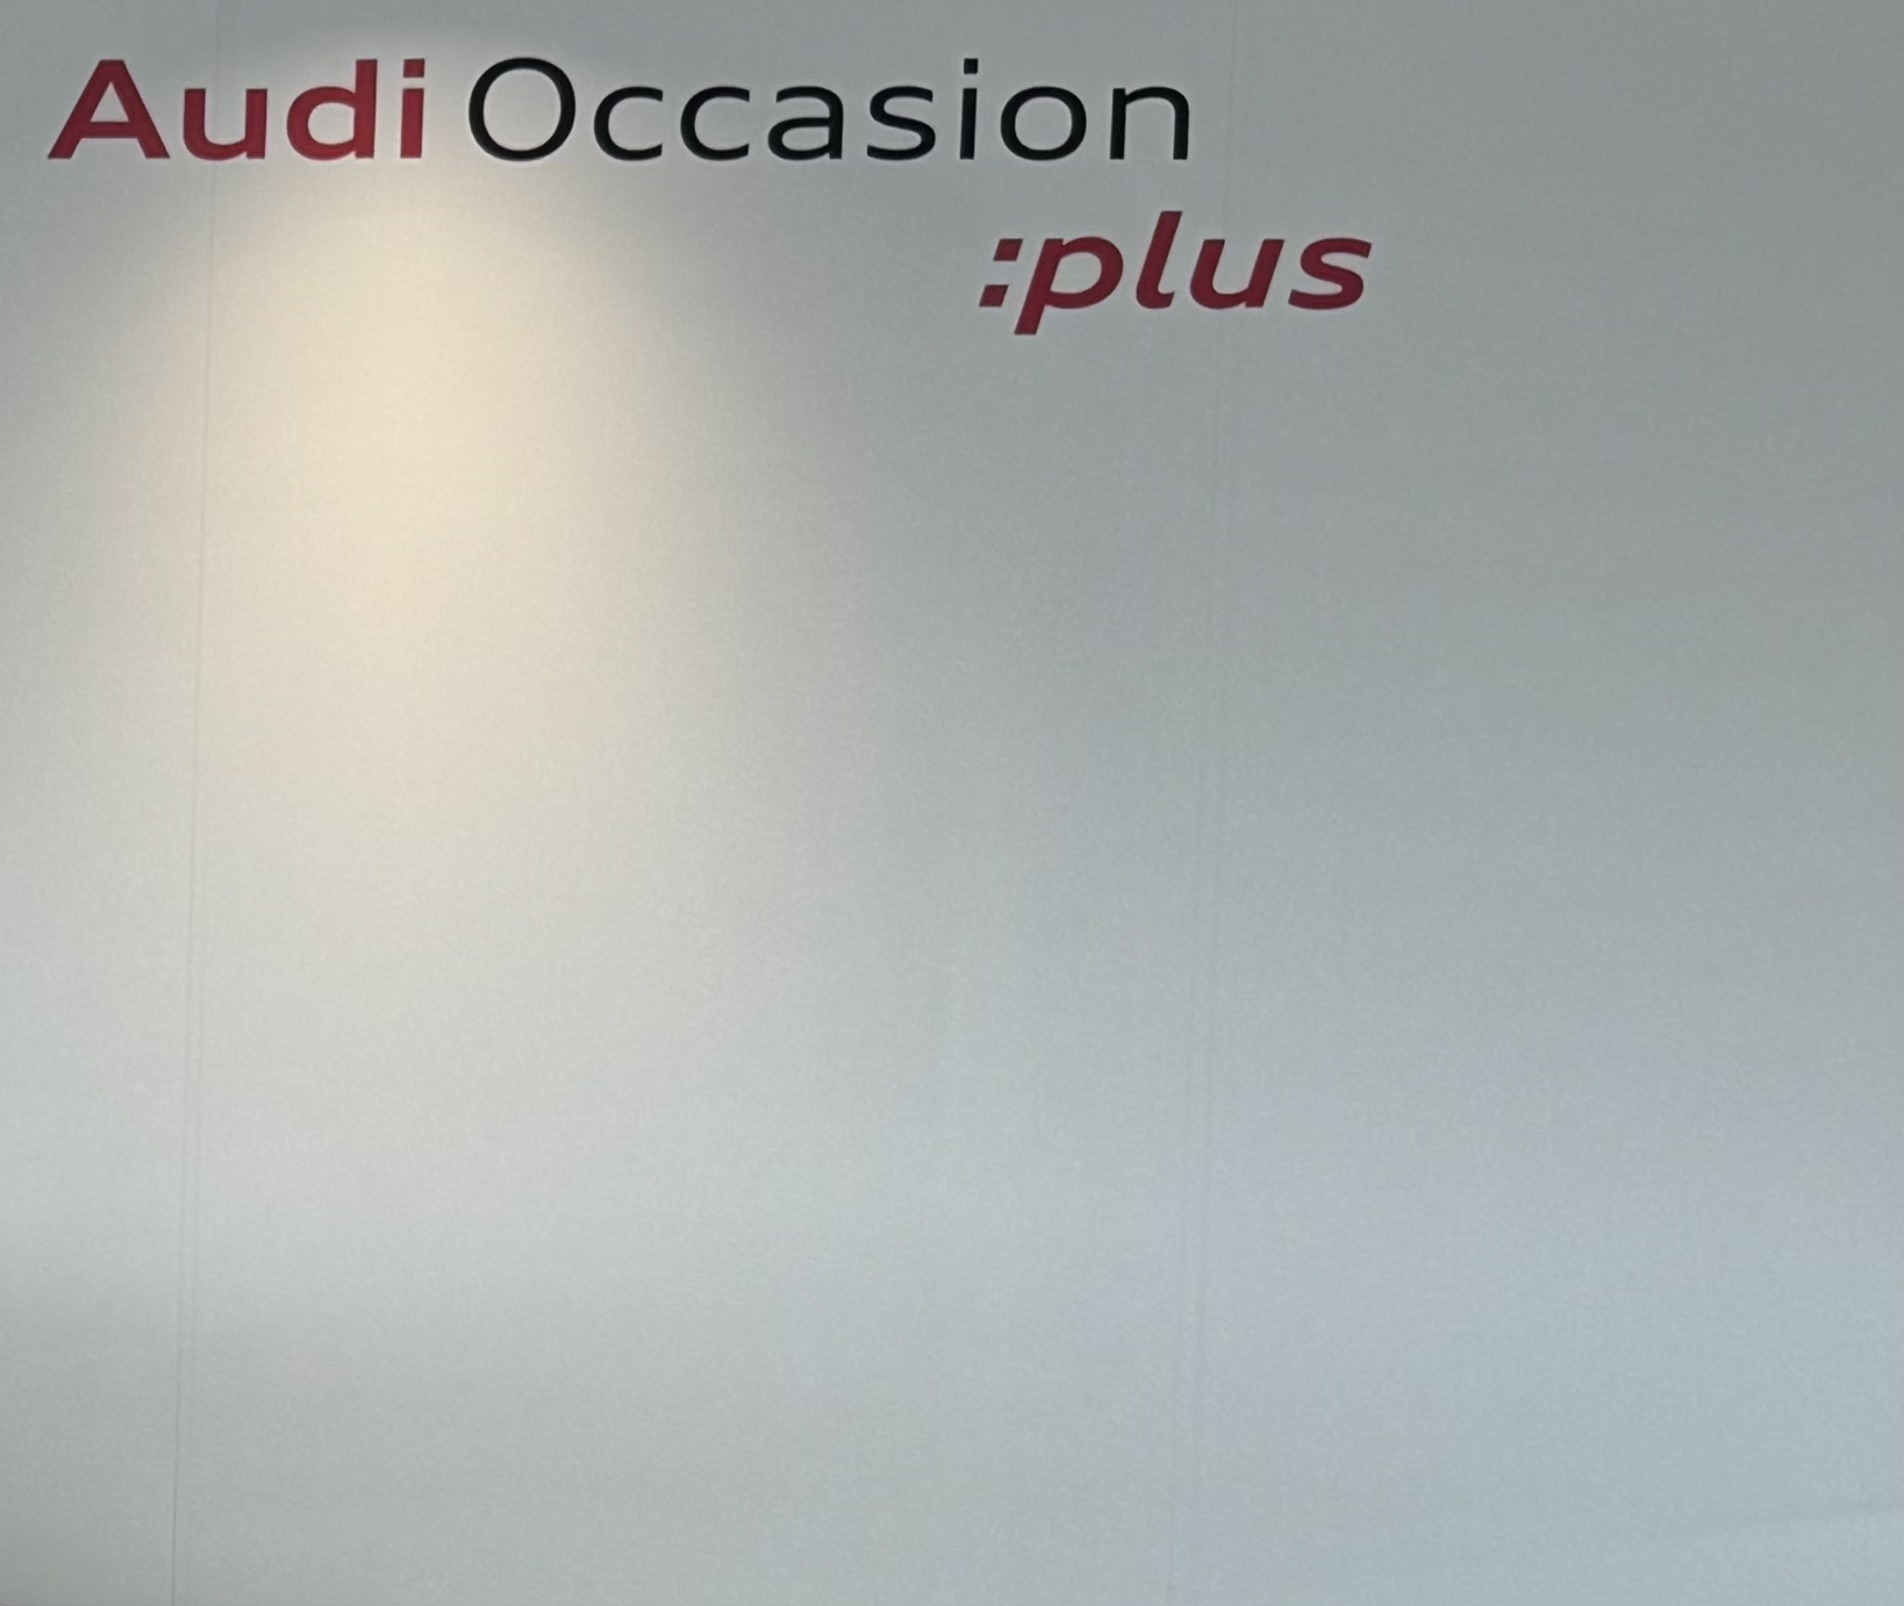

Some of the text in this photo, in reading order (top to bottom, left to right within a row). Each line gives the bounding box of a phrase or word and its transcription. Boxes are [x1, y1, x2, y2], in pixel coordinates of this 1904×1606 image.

[51, 57, 1191, 162] Audi Occasion
[980, 211, 1372, 334] :plus
